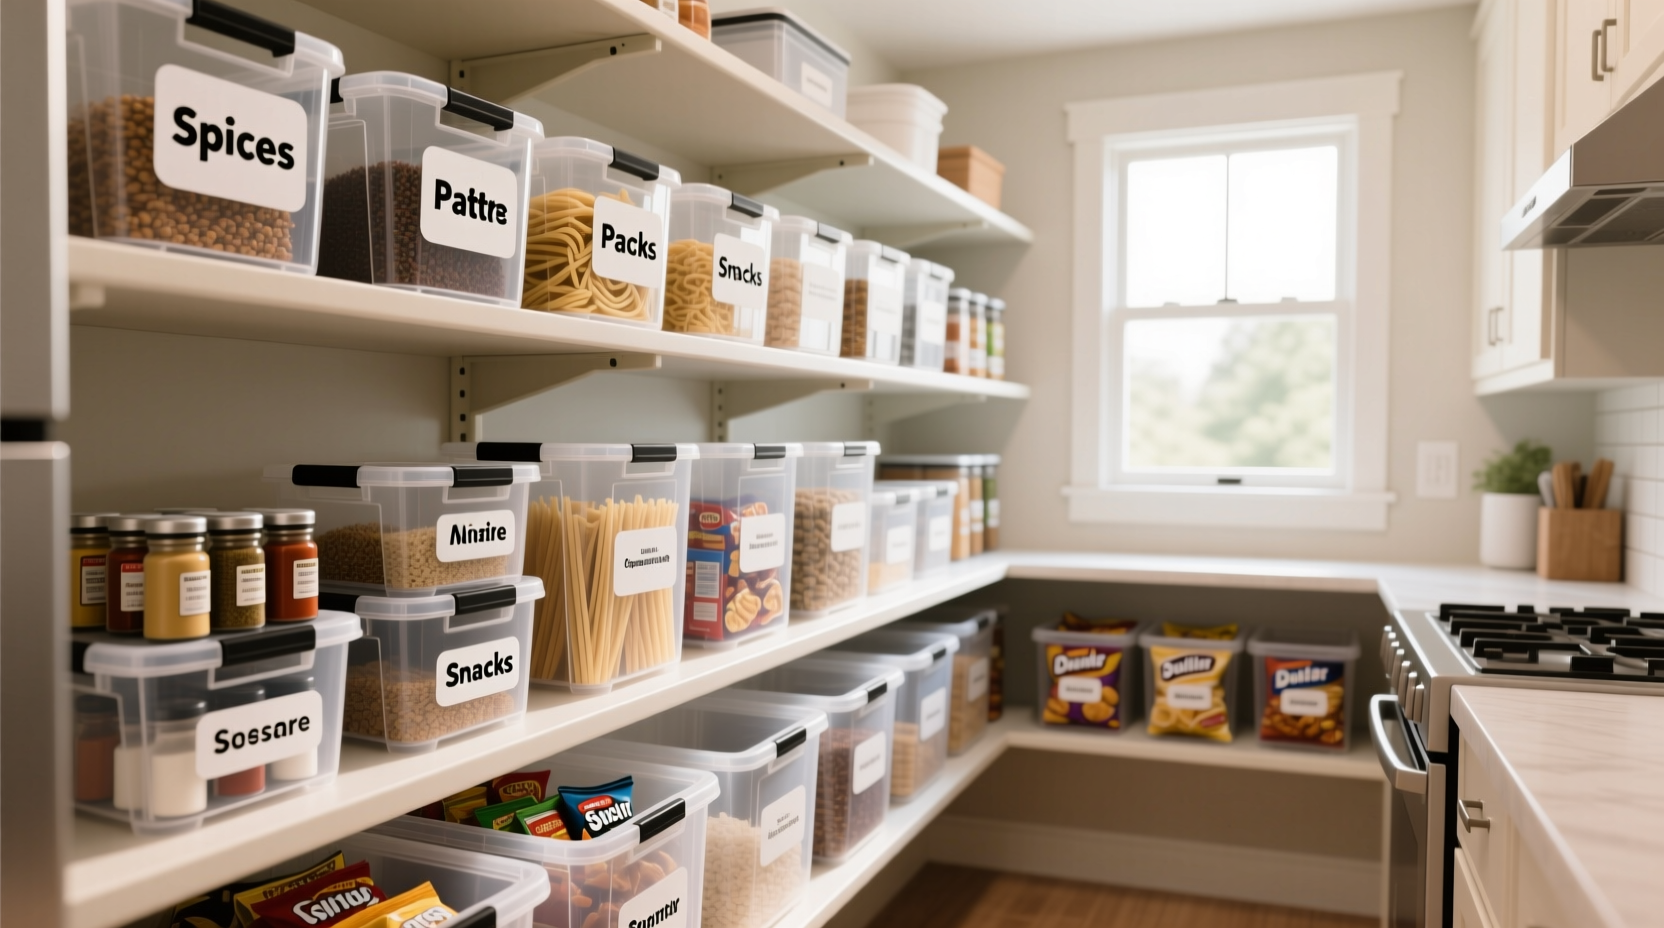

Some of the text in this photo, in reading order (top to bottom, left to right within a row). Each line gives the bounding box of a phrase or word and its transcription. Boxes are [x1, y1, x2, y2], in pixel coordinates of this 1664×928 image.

[172, 106, 295, 170] Spices
[601, 222, 657, 261] Packs
[445, 651, 513, 688] Snacks
